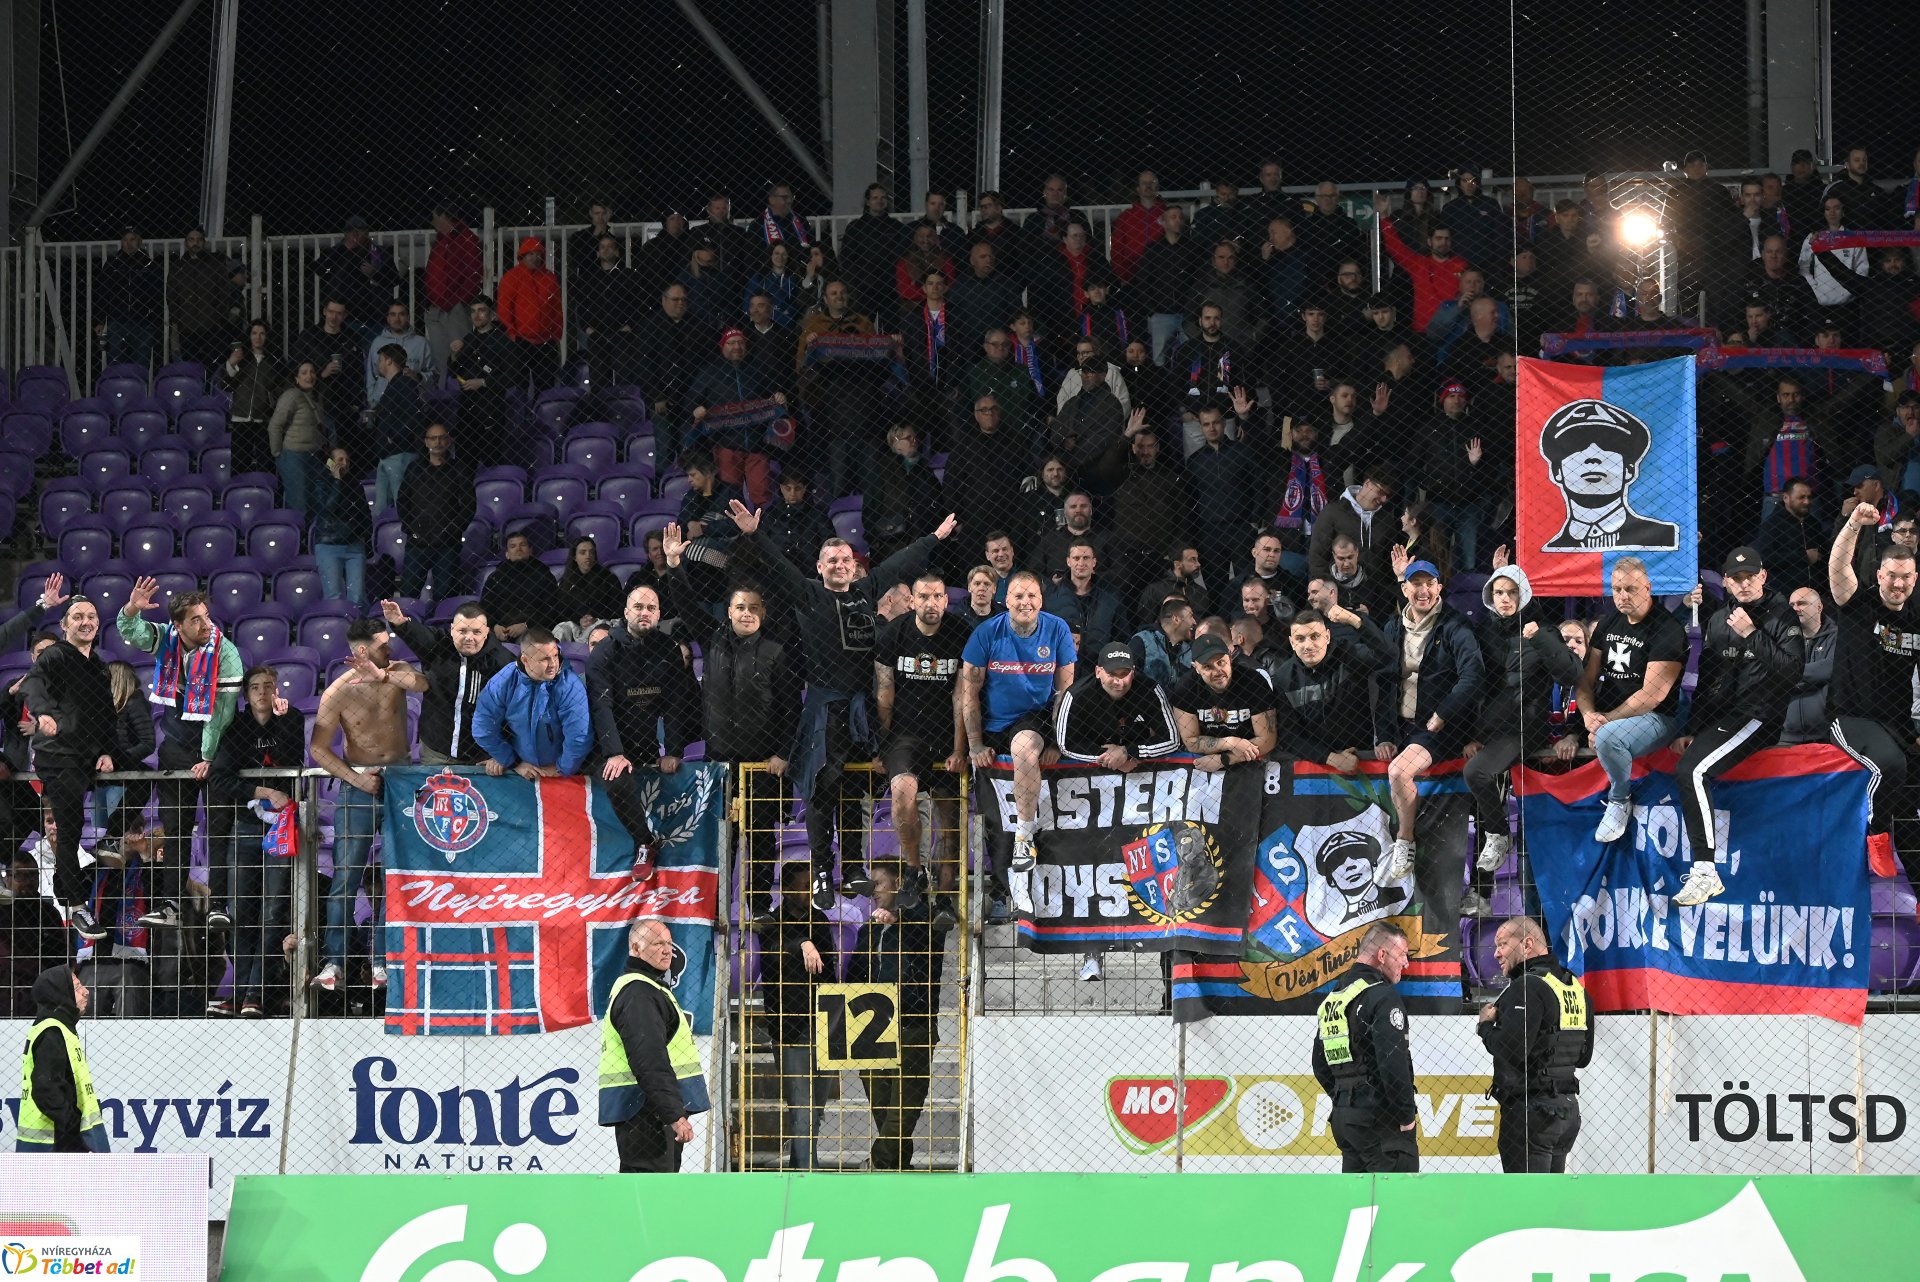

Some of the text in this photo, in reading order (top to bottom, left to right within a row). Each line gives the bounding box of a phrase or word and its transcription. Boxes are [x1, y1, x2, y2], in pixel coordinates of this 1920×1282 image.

[1107, 650, 1131, 659] adidas
[1678, 890, 1855, 971] VELÜNK!
[1275, 965, 1320, 993] Vén
[817, 992, 898, 1061] 12
[1675, 1080, 1907, 1144] TÖLTSD
[384, 1153, 544, 1172] NATURA
